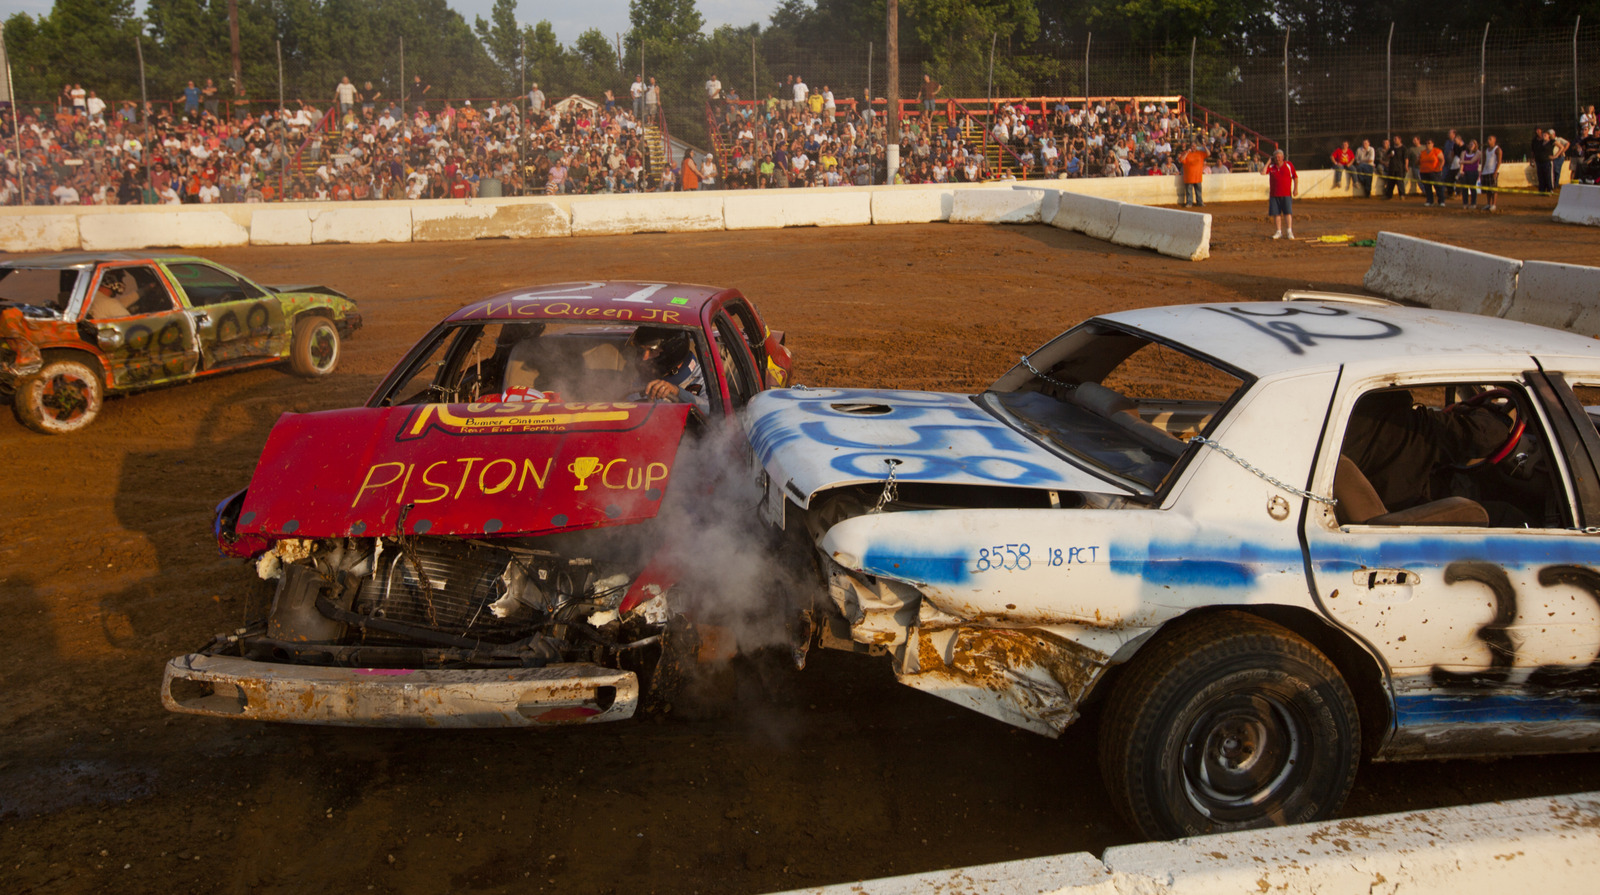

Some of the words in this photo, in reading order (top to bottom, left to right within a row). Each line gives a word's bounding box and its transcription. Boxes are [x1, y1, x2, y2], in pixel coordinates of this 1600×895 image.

[641, 308, 681, 322] JR
[465, 417, 504, 426] Bumper
[508, 417, 557, 425] Ointment
[352, 457, 553, 508] PISTON
[976, 543, 1032, 571] 8558
[1047, 547, 1064, 567] 18
